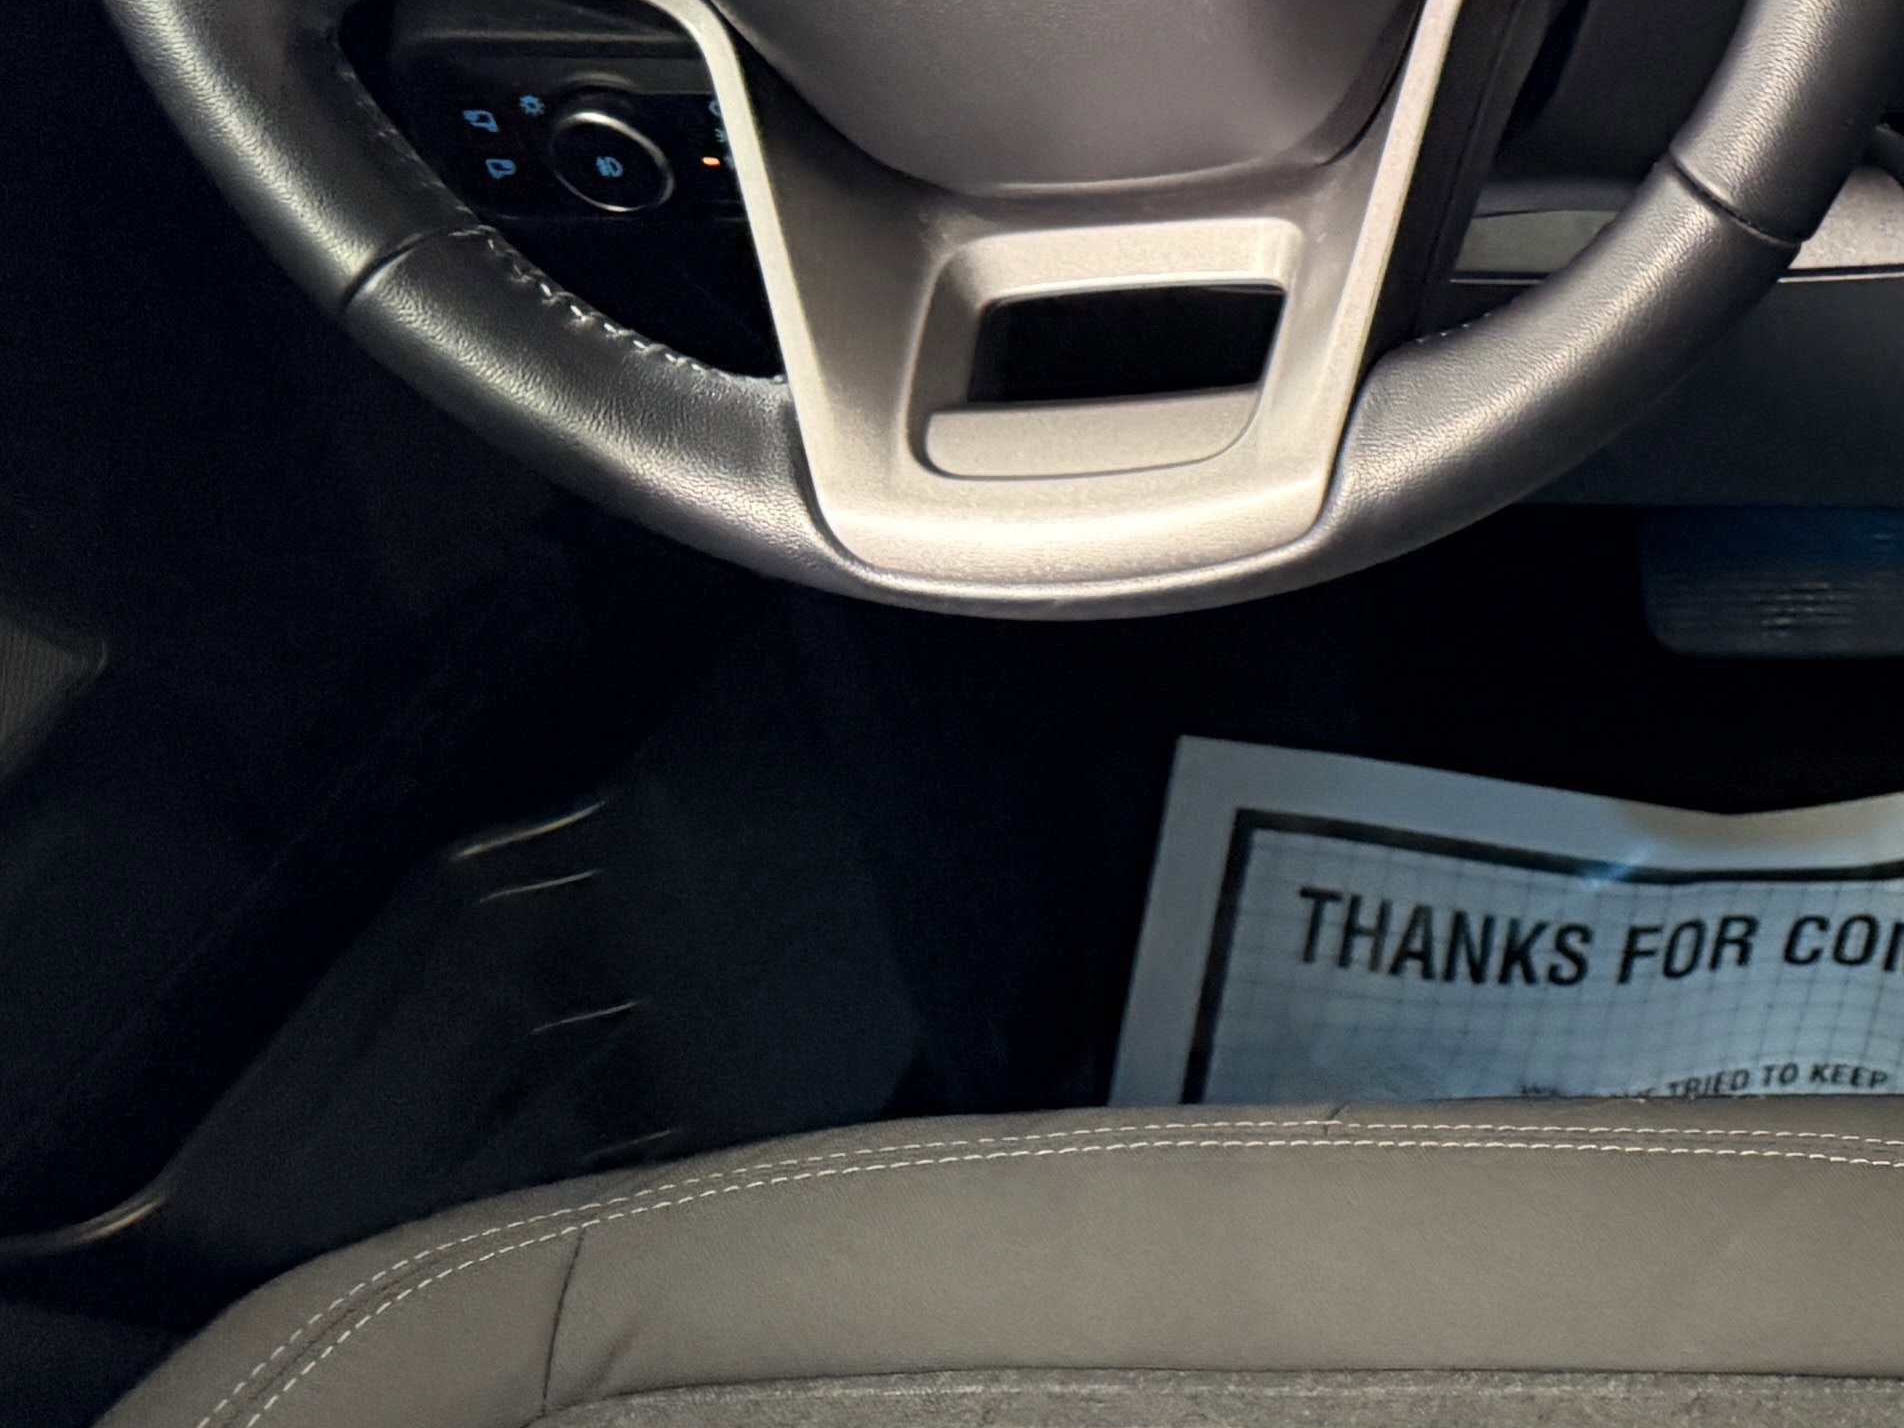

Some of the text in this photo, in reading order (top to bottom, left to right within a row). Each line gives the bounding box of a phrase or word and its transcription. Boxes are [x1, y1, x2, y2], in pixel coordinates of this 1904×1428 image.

[1299, 886, 1593, 986] THANKS
[1616, 911, 1758, 986] FOR
[1667, 1068, 1750, 1097] TRIED
[1762, 1062, 1799, 1087] TO
[1808, 1062, 1889, 1089] KEEP
